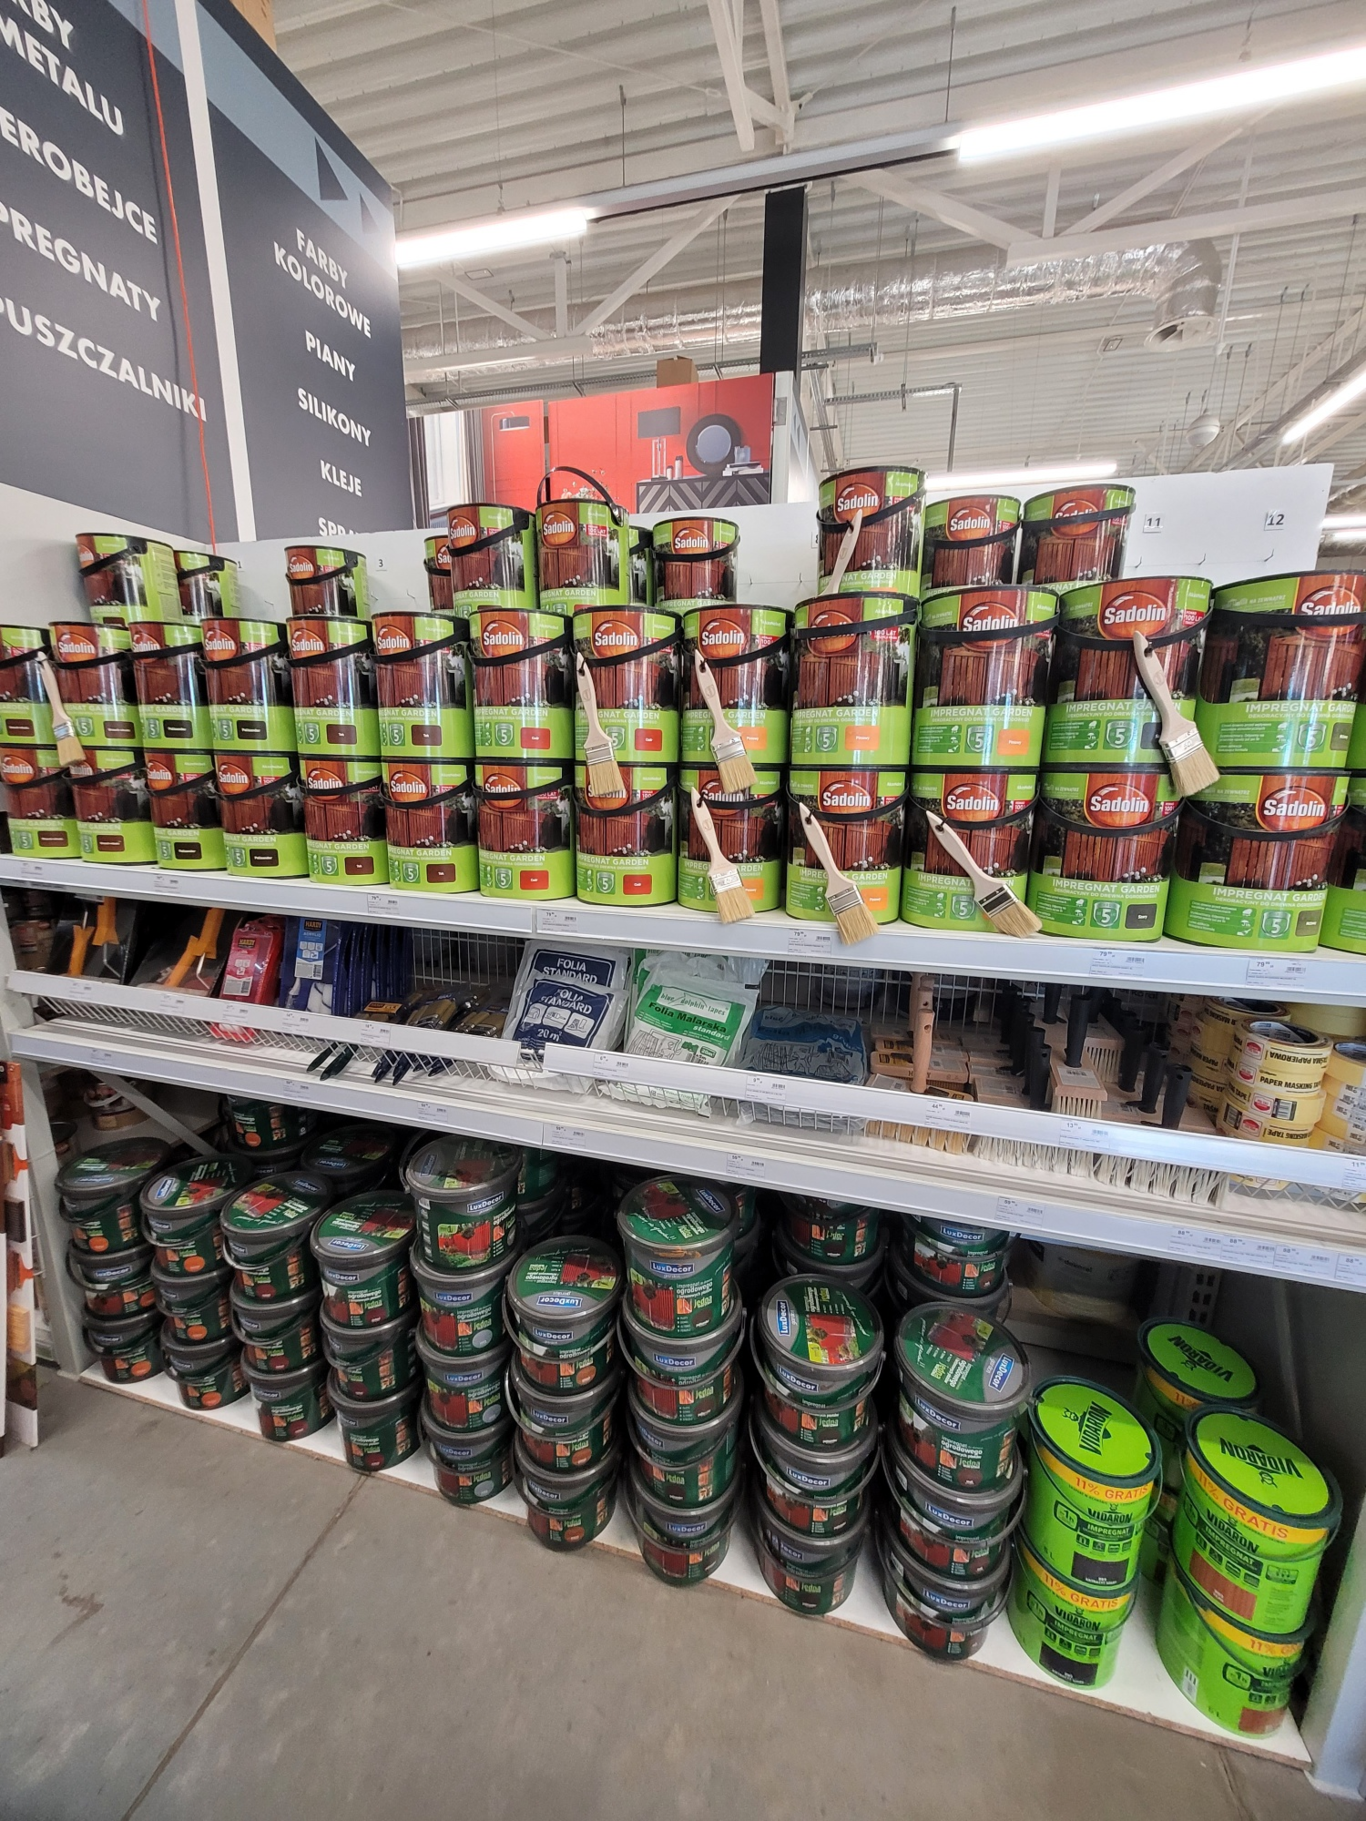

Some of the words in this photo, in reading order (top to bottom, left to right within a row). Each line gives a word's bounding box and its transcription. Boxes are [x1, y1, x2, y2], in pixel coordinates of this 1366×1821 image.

[12, 0, 74, 51] BY
[296, 227, 348, 289] FARBY
[274, 241, 372, 339] KOLOROWE
[0, 296, 207, 422] USZCZALNIKI
[305, 330, 356, 382] PIANY
[298, 387, 372, 447] SILIKONY
[320, 459, 363, 498] KLEJE
[837, 494, 879, 512] Sadolin
[950, 516, 991, 532] Sadolin
[1145, 517, 1162, 528] 11
[1266, 513, 1285, 527] 12
[450, 525, 476, 540] Sadolin
[543, 521, 575, 535] Sadolin
[675, 536, 709, 549] Sadolin
[289, 562, 314, 574] Sadolin
[378, 558, 384, 568] 3
[861, 572, 897, 581] GARDEN
[565, 589, 596, 597] GARDEN
[1104, 604, 1167, 625] Sadolin
[963, 614, 1019, 632] Sadolin
[205, 638, 235, 651] Sadolin
[377, 636, 410, 650] Sadolin
[483, 631, 524, 646] Sadolin
[594, 631, 639, 646] Sadolin
[701, 630, 745, 646] Sadolin
[58, 641, 96, 655] Sadolin
[291, 639, 324, 652] Sadolin
[316, 709, 351, 717] GARDEN
[401, 709, 437, 717] GARDEN
[511, 708, 548, 717] GARDEN
[836, 708, 879, 718] GARDEN
[930, 707, 988, 717] IMPREGNAT
[991, 707, 1033, 717] GARDEN
[1066, 702, 1132, 713] IMPREGNAT
[1245, 703, 1325, 713] IMPREGNAT
[624, 711, 660, 720] GARDEN
[728, 711, 766, 720] GARDEN
[82, 723, 88, 733] 5
[223, 726, 229, 736] 5
[309, 729, 315, 739] 5
[393, 729, 400, 740] 5
[500, 728, 508, 741] 5
[821, 733, 830, 747] 5
[974, 733, 984, 747] 5
[1113, 728, 1125, 746] 5
[1307, 732, 1318, 747] 5
[2, 763, 34, 775] Sadolin
[218, 772, 249, 784] Sadolin
[390, 780, 426, 794] Sadolin
[822, 791, 871, 808] Sadolin
[946, 795, 999, 812] Sadolin
[1090, 795, 1149, 814] Sadolin
[1263, 798, 1325, 818] Sadolin
[93, 822, 121, 831] GARDEN
[242, 835, 277, 843] GARDEN
[334, 842, 369, 850] GARDEN
[236, 852, 242, 864] 5
[416, 849, 452, 857] GARDEN
[510, 854, 546, 862] GARDEN
[325, 860, 333, 872] 5
[612, 857, 649, 866] GARDEN
[407, 867, 415, 880] 5
[500, 873, 508, 885] 5
[852, 870, 888, 881] GARDEN
[918, 874, 971, 887] IMPREGNAT
[601, 878, 609, 892] 5
[1052, 878, 1117, 893] IMPREGNAT
[1120, 883, 1160, 893] GARDEN
[1212, 887, 1290, 902] IMPREGNAT
[1292, 893, 1326, 903] GARDEN
[958, 900, 969, 914] 5
[1100, 908, 1112, 922] 5
[1269, 918, 1282, 935] 5
[556, 957, 587, 972] FOLIA
[543, 966, 598, 984] STANDARD
[660, 993, 675, 1001] blue
[680, 998, 705, 1010] dolphin
[707, 1005, 726, 1016] tapes
[648, 1002, 674, 1017] Folia
[676, 1012, 727, 1033] Malarska
[537, 1028, 549, 1038] 20
[692, 1025, 731, 1041] standard
[1269, 1051, 1313, 1065] PAPIEROWA
[1259, 1075, 1284, 1088] PAPER
[1284, 1080, 1313, 1090] MASKING
[1267, 1128, 1286, 1138] TAPE
[469, 1194, 503, 1212] LuxDecor
[699, 1189, 723, 1212] LuxDecor
[942, 1227, 984, 1240] LuxDecor
[652, 1263, 693, 1273] LuxDecor
[677, 1283, 713, 1295] ogrodowego
[436, 1293, 471, 1302] LuxDecor
[540, 1296, 580, 1307] LuxDecor
[777, 1300, 789, 1335] LuxDecor
[535, 1329, 572, 1340] LuxDecor
[654, 1355, 695, 1367] LuxDecor
[1167, 1334, 1234, 1383] VIDARON
[446, 1373, 482, 1382] LuxDecor
[778, 1366, 818, 1391] LuxDecor
[989, 1354, 1014, 1390] LuxDecor
[532, 1409, 567, 1423] LuxDecor
[916, 1396, 961, 1430] LuxDecor
[1079, 1400, 1113, 1456] VIDARON
[941, 1440, 983, 1455] ogrodowego
[1219, 1437, 1304, 1480] VIDARON
[787, 1467, 830, 1487] LuxDecor
[530, 1481, 560, 1499] LuxDecor
[1075, 1476, 1100, 1497] 11%
[1104, 1483, 1150, 1501] GRATIS
[1198, 1472, 1219, 1500] 11%
[1223, 1497, 1289, 1539] GRATIS
[926, 1503, 973, 1527] LuxDecor
[1087, 1507, 1133, 1524] VIDARON
[667, 1523, 706, 1534] LuxDecor
[1087, 1523, 1130, 1536] IMPREGNAT
[1206, 1508, 1260, 1553] VIDARON
[1205, 1525, 1255, 1565] IMPREGNAT
[1041, 1571, 1067, 1597] 11%
[1069, 1591, 1120, 1610] GRATIS
[924, 1589, 969, 1609] LuxDecor
[1054, 1604, 1101, 1632] VIDARON
[1053, 1619, 1099, 1641] IMPREGNAT
[1250, 1639, 1277, 1656] 11%
